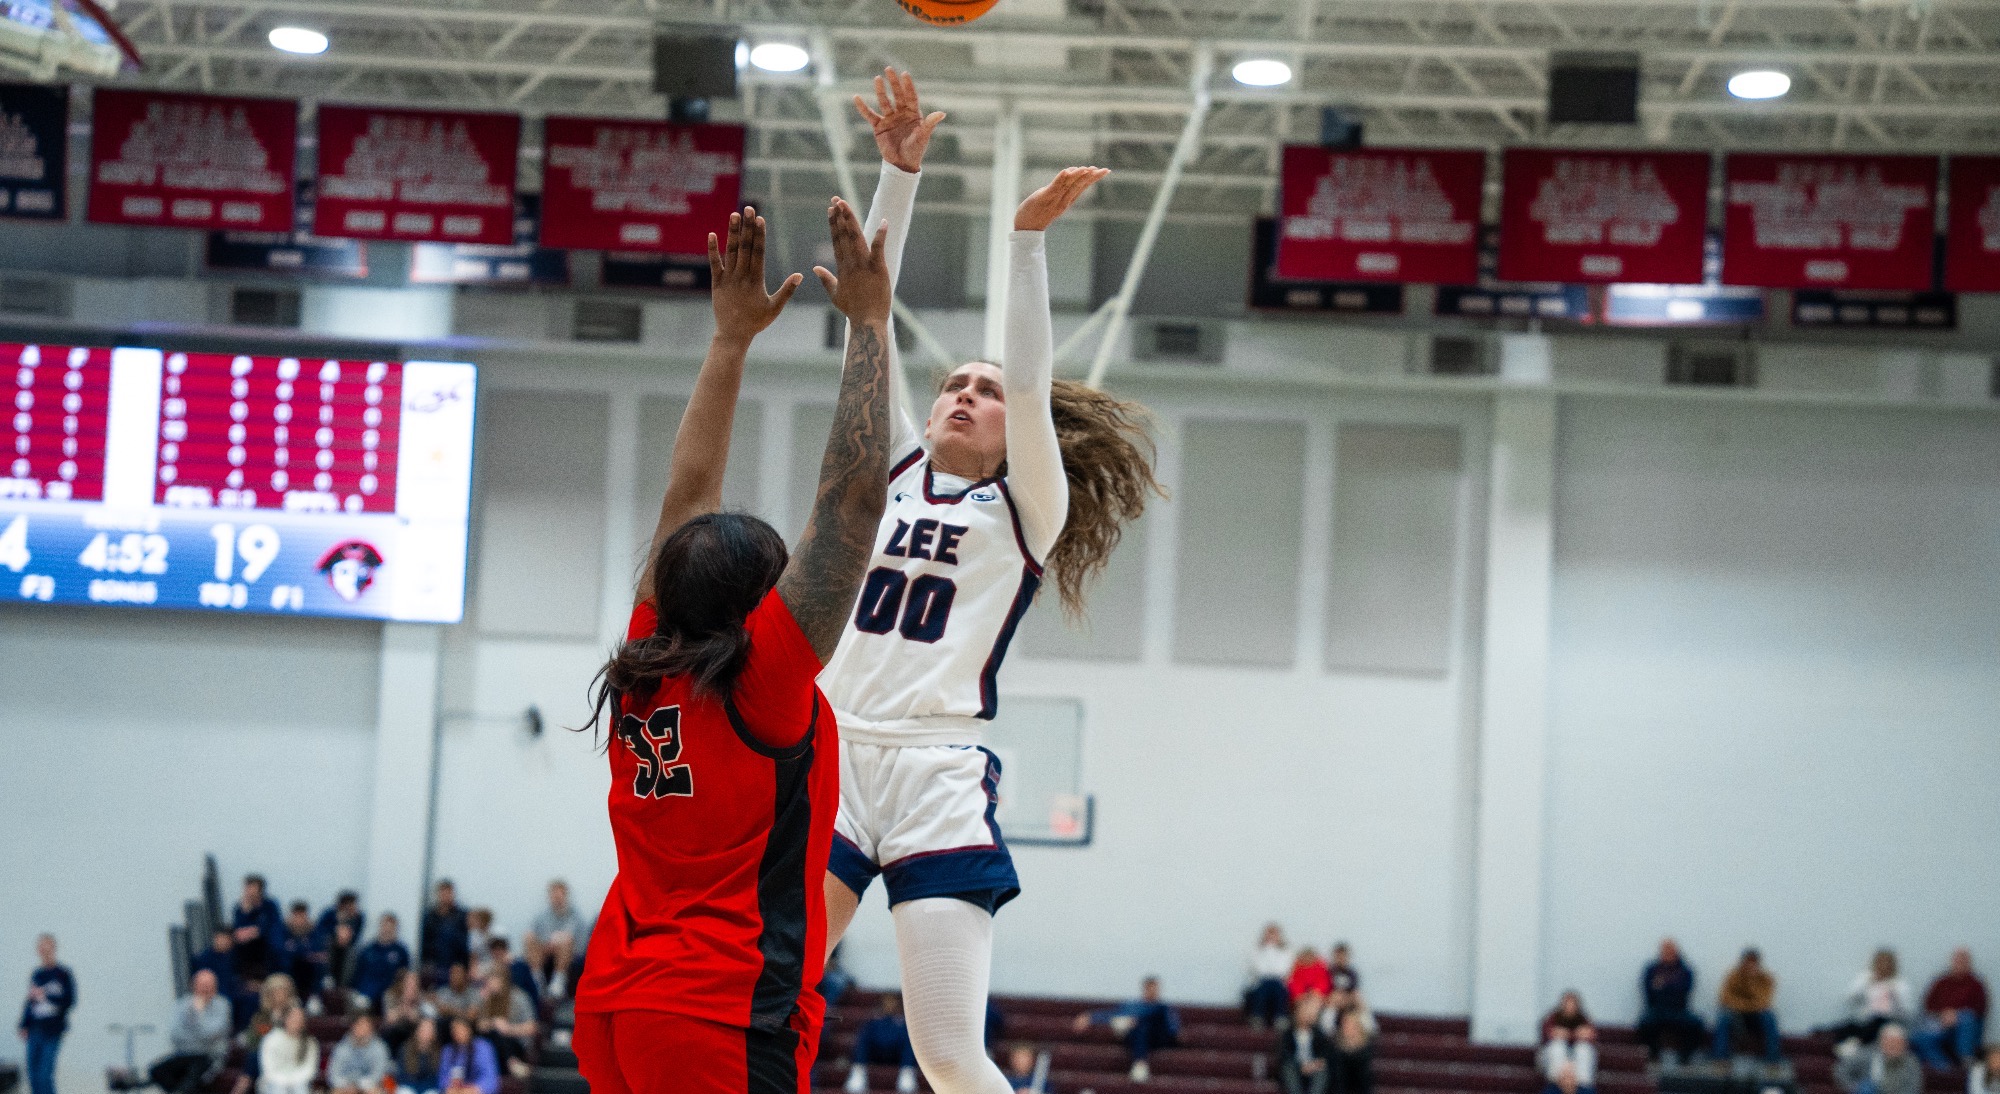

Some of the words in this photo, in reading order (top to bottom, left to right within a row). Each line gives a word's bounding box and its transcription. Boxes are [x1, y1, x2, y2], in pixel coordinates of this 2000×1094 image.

[79, 532, 169, 574] 4:52
[210, 522, 280, 583] 19
[883, 518, 969, 566] LEE
[854, 566, 957, 644] 00
[618, 704, 694, 800] 32
